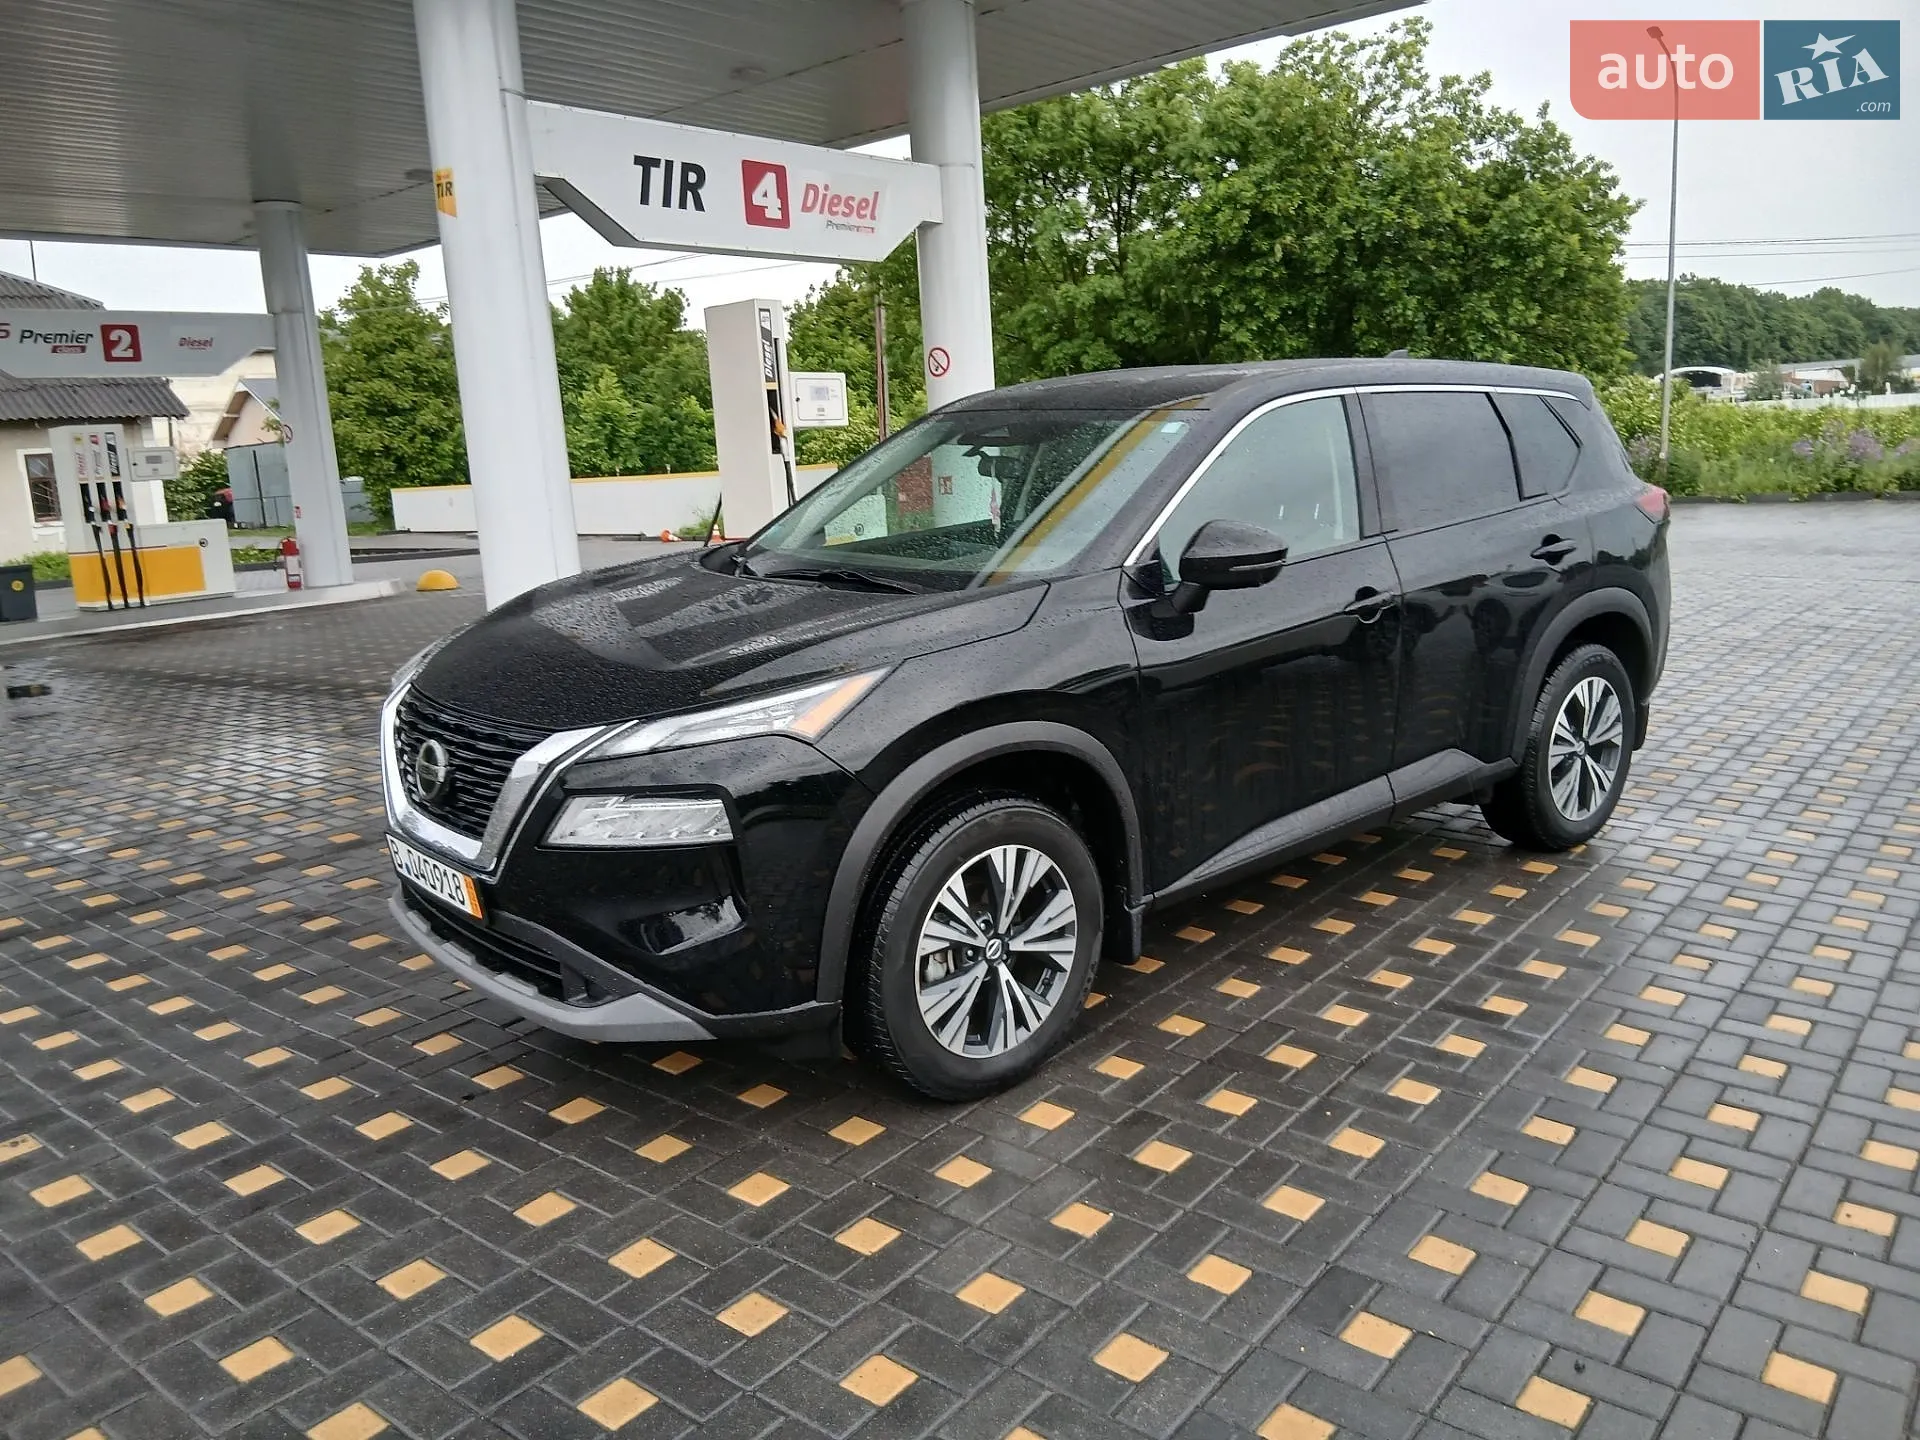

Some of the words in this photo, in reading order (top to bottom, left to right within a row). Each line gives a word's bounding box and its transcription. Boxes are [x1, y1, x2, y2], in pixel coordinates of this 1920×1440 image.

[436, 181, 453, 199] TIR
[633, 154, 707, 213] TIR
[751, 171, 783, 220] 4
[801, 183, 880, 221] Diesel
[19, 329, 94, 344] Premier
[109, 328, 134, 358] 2
[178, 336, 213, 347] Diesel
[762, 339, 774, 378] Diesel
